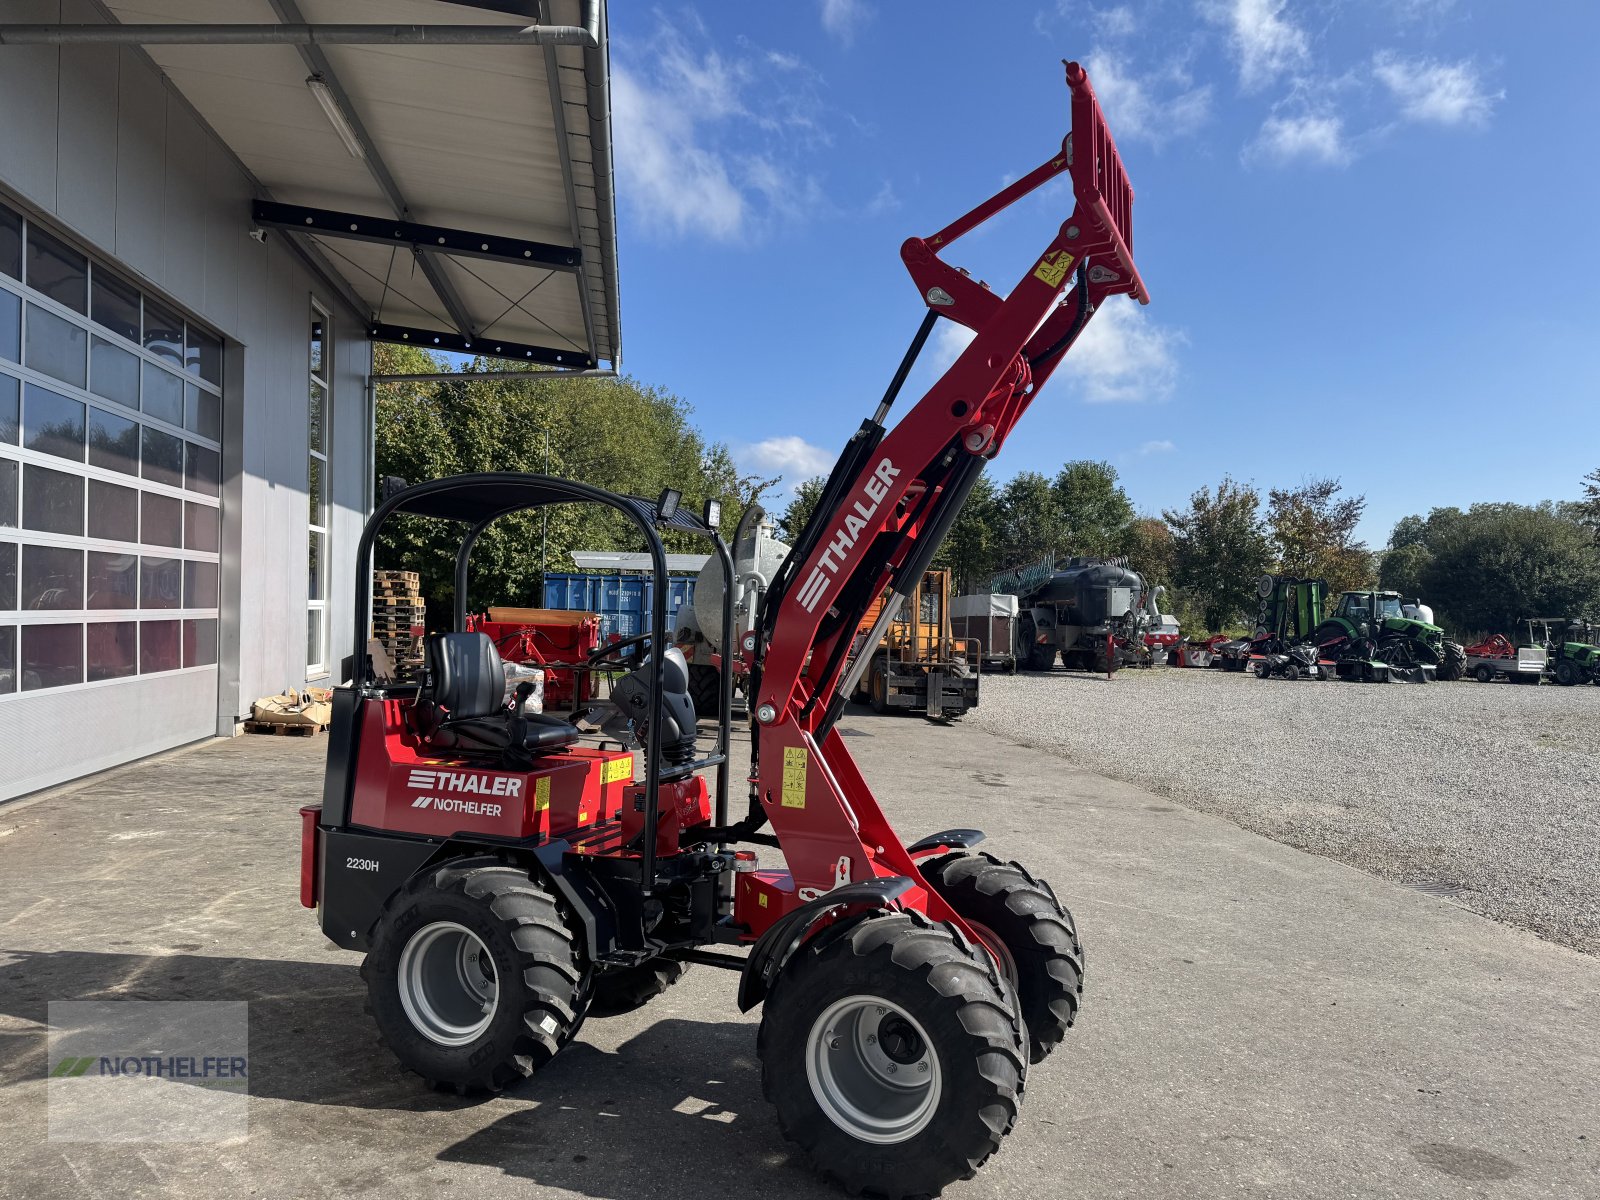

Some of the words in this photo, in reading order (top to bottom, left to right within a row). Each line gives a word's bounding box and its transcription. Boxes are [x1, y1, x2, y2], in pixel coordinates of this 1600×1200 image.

[817, 457, 901, 574] THALER
[437, 771, 522, 797] THALER
[433, 798, 502, 817] NOTHELFER
[346, 857, 379, 872] 2230H
